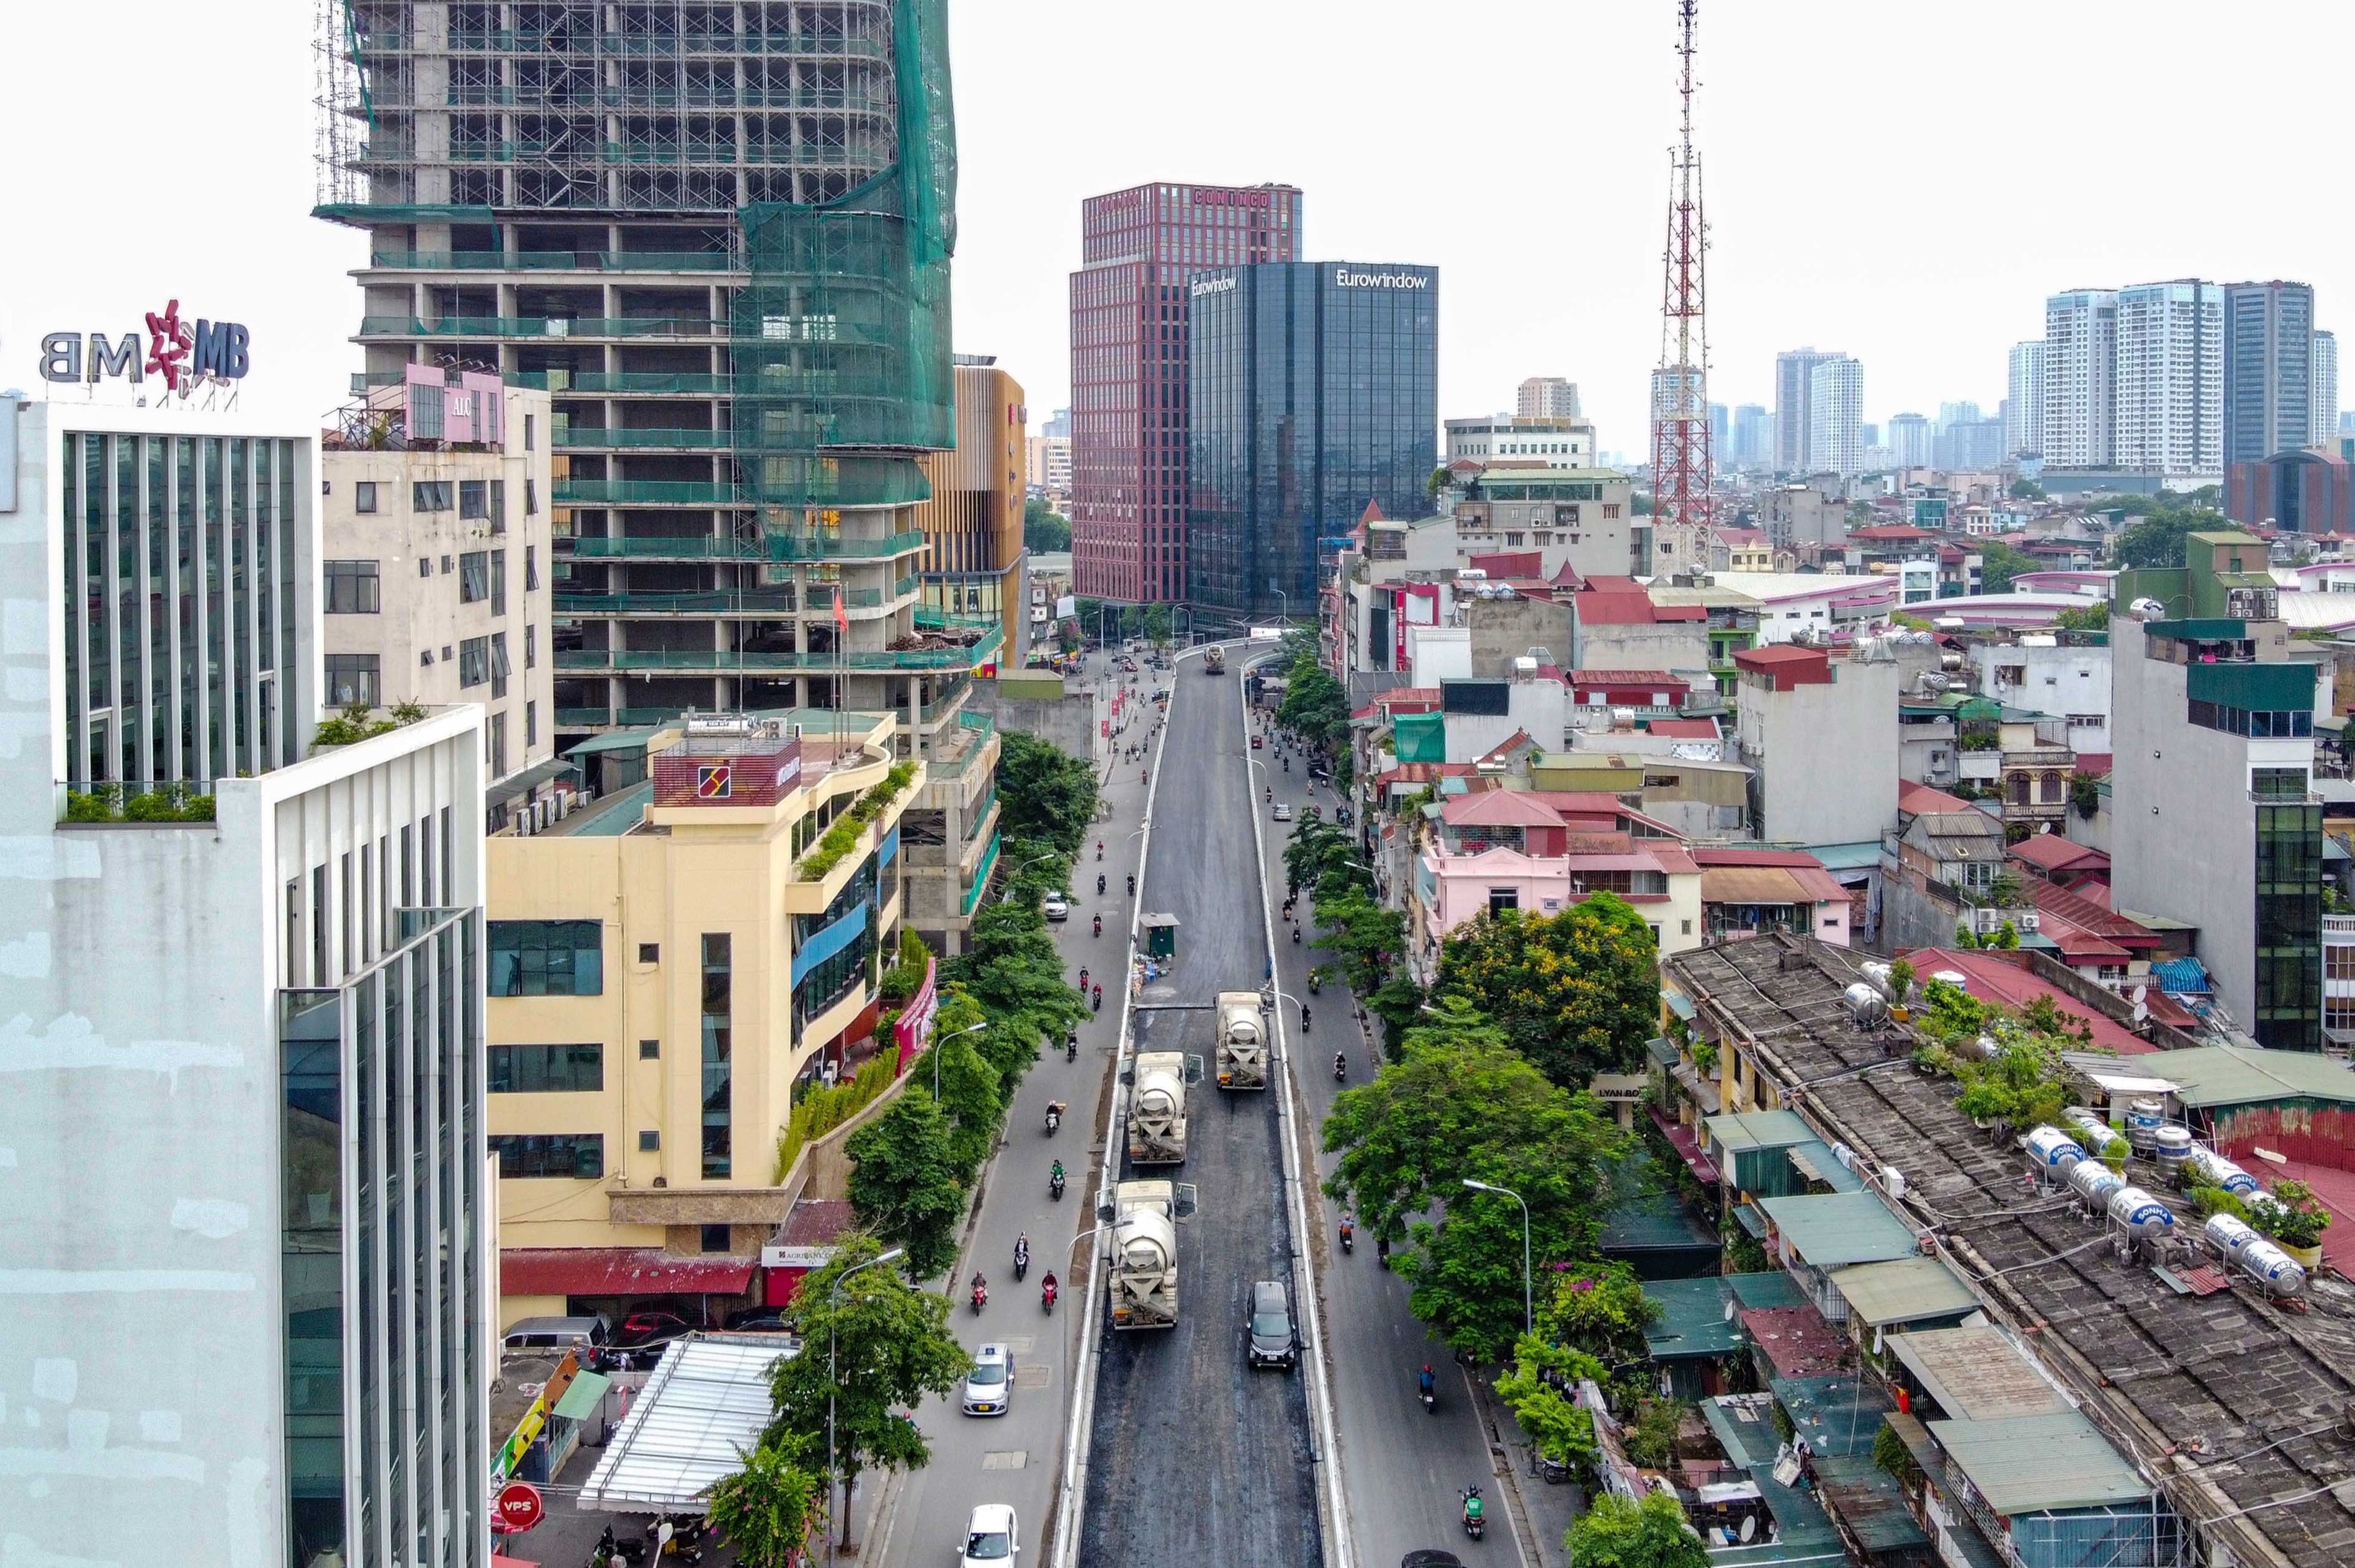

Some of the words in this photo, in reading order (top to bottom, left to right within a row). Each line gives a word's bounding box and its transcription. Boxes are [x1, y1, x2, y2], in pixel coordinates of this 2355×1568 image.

[1194, 189, 1268, 207] CONINCO
[1192, 277, 1237, 297] Eurowindow
[1336, 269, 1427, 289] Eurowindow
[192, 318, 249, 379] MB
[452, 397, 472, 416] ALC
[1599, 1089, 1623, 1097] LYAN
[1625, 1089, 1641, 1097] BO
[2052, 1145, 2084, 1158] SONHA
[2228, 1175, 2256, 1189] SONHA
[2137, 1206, 2169, 1221] SONHA
[503, 1501, 532, 1512] VPS
